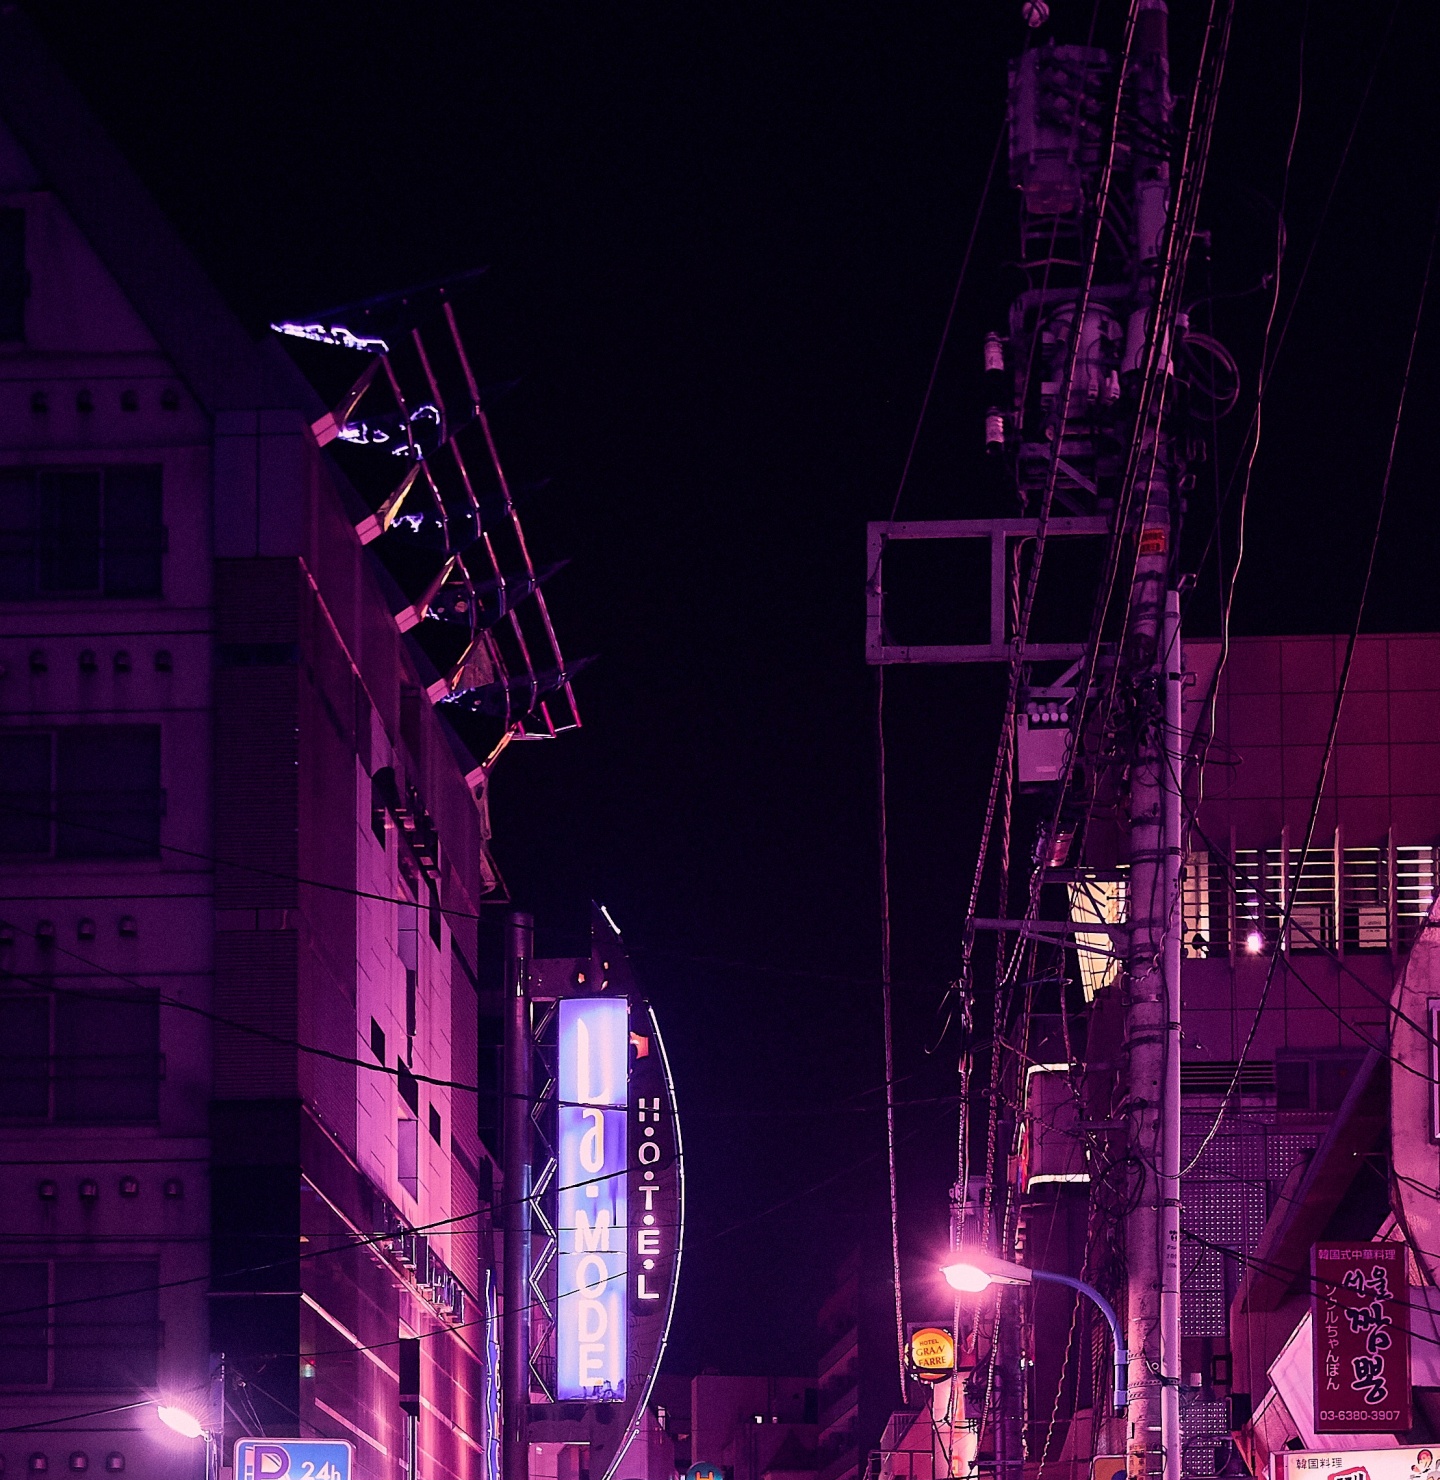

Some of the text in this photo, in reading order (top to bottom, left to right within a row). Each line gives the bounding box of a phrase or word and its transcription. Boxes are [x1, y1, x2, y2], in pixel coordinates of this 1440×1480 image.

[1318, 1249, 1396, 1260] 韓国式中華料理
[1325, 1284, 1340, 1391] ソウルちゃんぽん
[916, 1345, 945, 1356] GRAN
[1320, 1411, 1400, 1421] 03-6380-3907
[1296, 1457, 1342, 1470] 韓国料理
